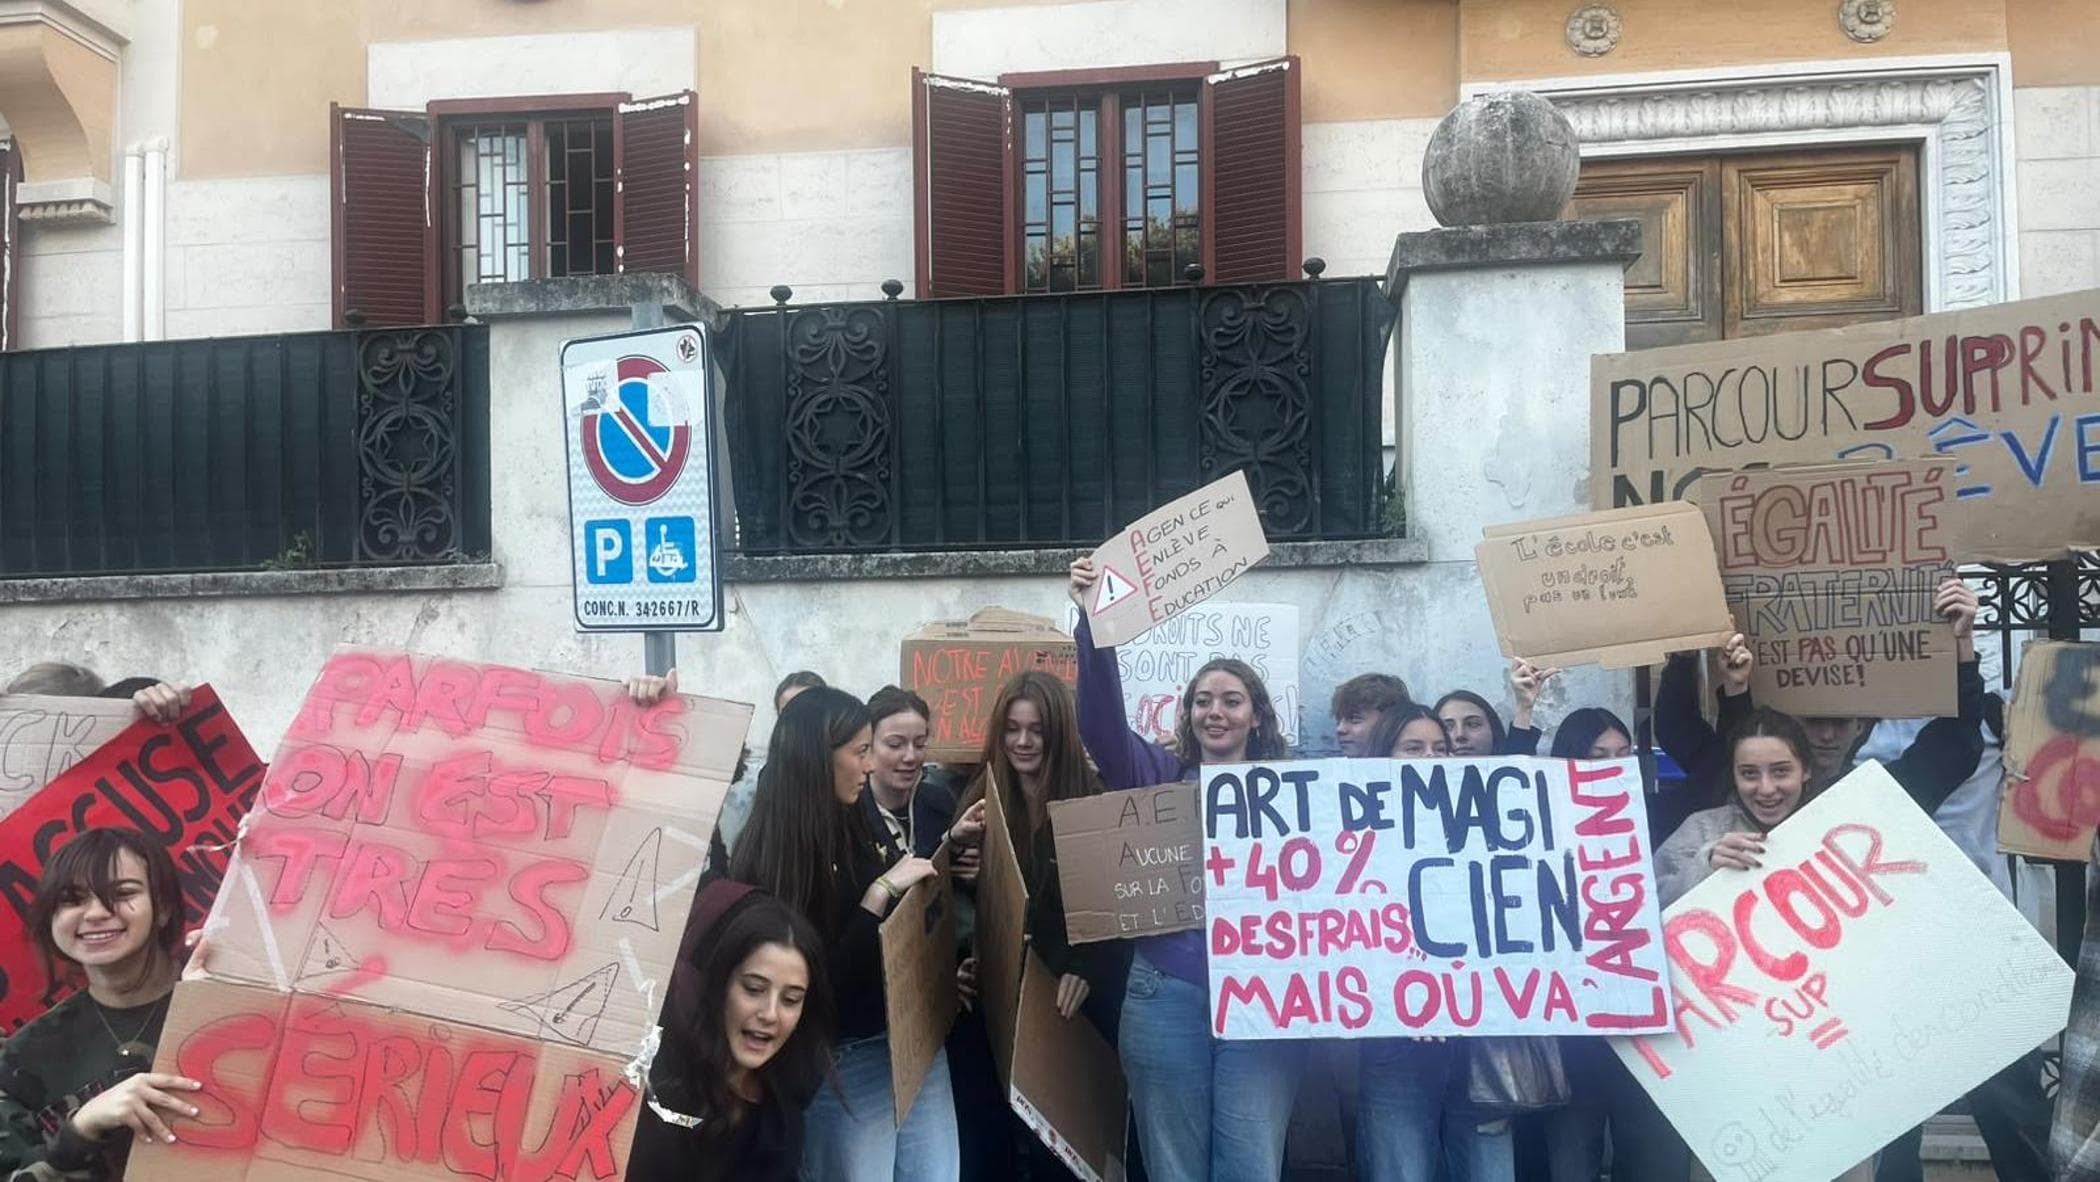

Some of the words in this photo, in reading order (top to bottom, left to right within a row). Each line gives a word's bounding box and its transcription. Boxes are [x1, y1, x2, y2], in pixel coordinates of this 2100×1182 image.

[1720, 467, 1947, 568] ÉGALITÉ
[596, 528, 622, 576] P
[1135, 525, 1210, 577] ENLÈVE
[1142, 557, 1202, 597] FONDS
[1211, 538, 1228, 558] À
[584, 600, 630, 617] CONC.N.
[635, 600, 700, 617] 342667/R
[1148, 556, 1248, 623] EDUCATION
[1230, 614, 1272, 649] NE
[1797, 635, 1837, 664] PAS
[1845, 629, 1932, 664] QU'UNE
[912, 648, 992, 692] NOTRE
[1117, 649, 1198, 683] SONT
[1776, 664, 1866, 689] DEVISE!
[308, 654, 692, 770] PARFOIS
[262, 743, 403, 825] ON
[417, 750, 617, 841] EST
[1206, 767, 1320, 839] ART
[1338, 781, 1395, 832] DE
[1400, 764, 1554, 853] MAGI
[1118, 842, 1194, 868] AUCUNE
[254, 829, 589, 961] TRES
[1114, 879, 1144, 900] SUR
[1149, 877, 1170, 896] LA
[1408, 849, 1583, 958] CIEN
[1567, 760, 1668, 1029] L'ARGENT
[1118, 913, 1139, 931] ET
[1211, 910, 1297, 960] DES
[1215, 965, 1373, 1034] MAIS
[1393, 960, 1483, 1028] OÙ
[1493, 965, 1578, 1023] VA
[1764, 971, 1829, 1038] SUP
